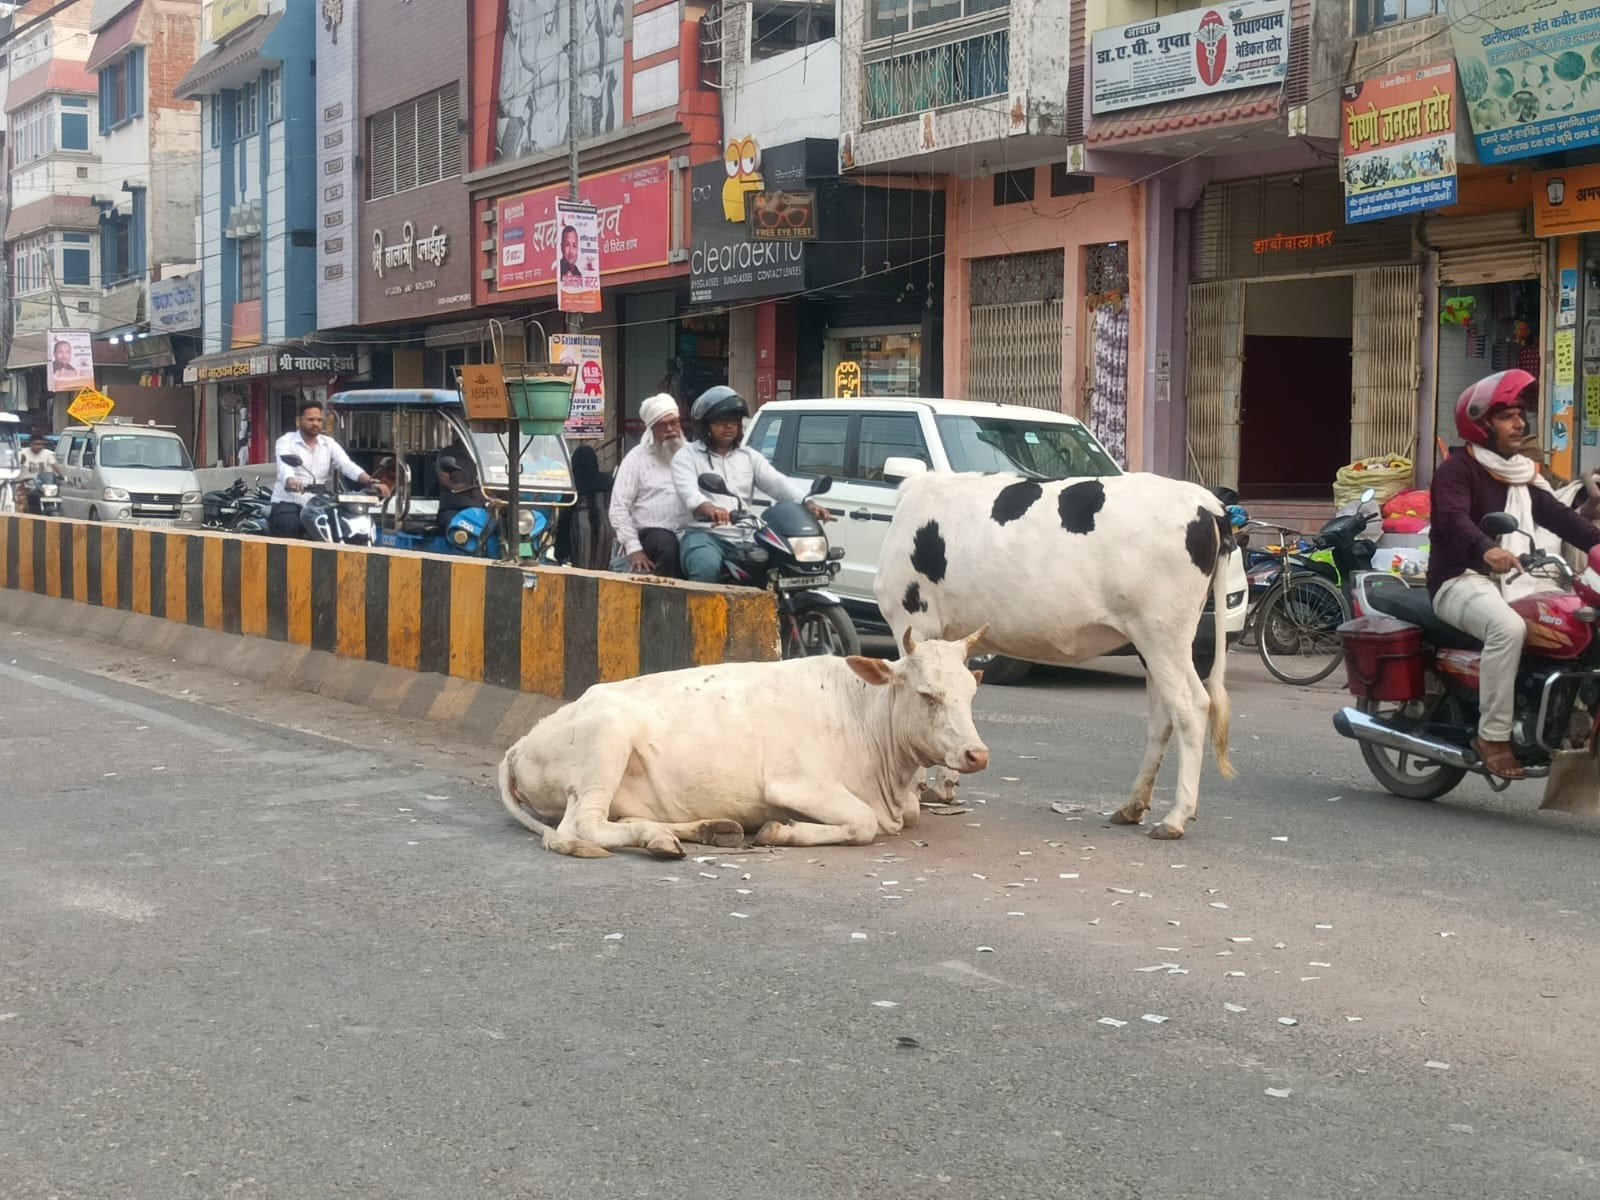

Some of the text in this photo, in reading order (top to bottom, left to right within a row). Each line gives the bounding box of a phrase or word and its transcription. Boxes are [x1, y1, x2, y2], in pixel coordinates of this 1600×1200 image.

[1232, 15, 1284, 36] राधाश्याम
[1532, 18, 1549, 33] संत
[1157, 33, 1192, 53] गुप्ता
[1235, 35, 1283, 59] मेडिकल स्टोर
[1346, 86, 1451, 150] वैष्णो जनरल स्टोर
[756, 226, 812, 237] FREE EYE TEST
[372, 221, 447, 278] श्री बालाजी प्लाईवुड
[723, 272, 753, 286] SUNGLASSES
[757, 268, 783, 281] CONTACT
[783, 265, 802, 277] LENSES
[279, 354, 293, 370] श्री
